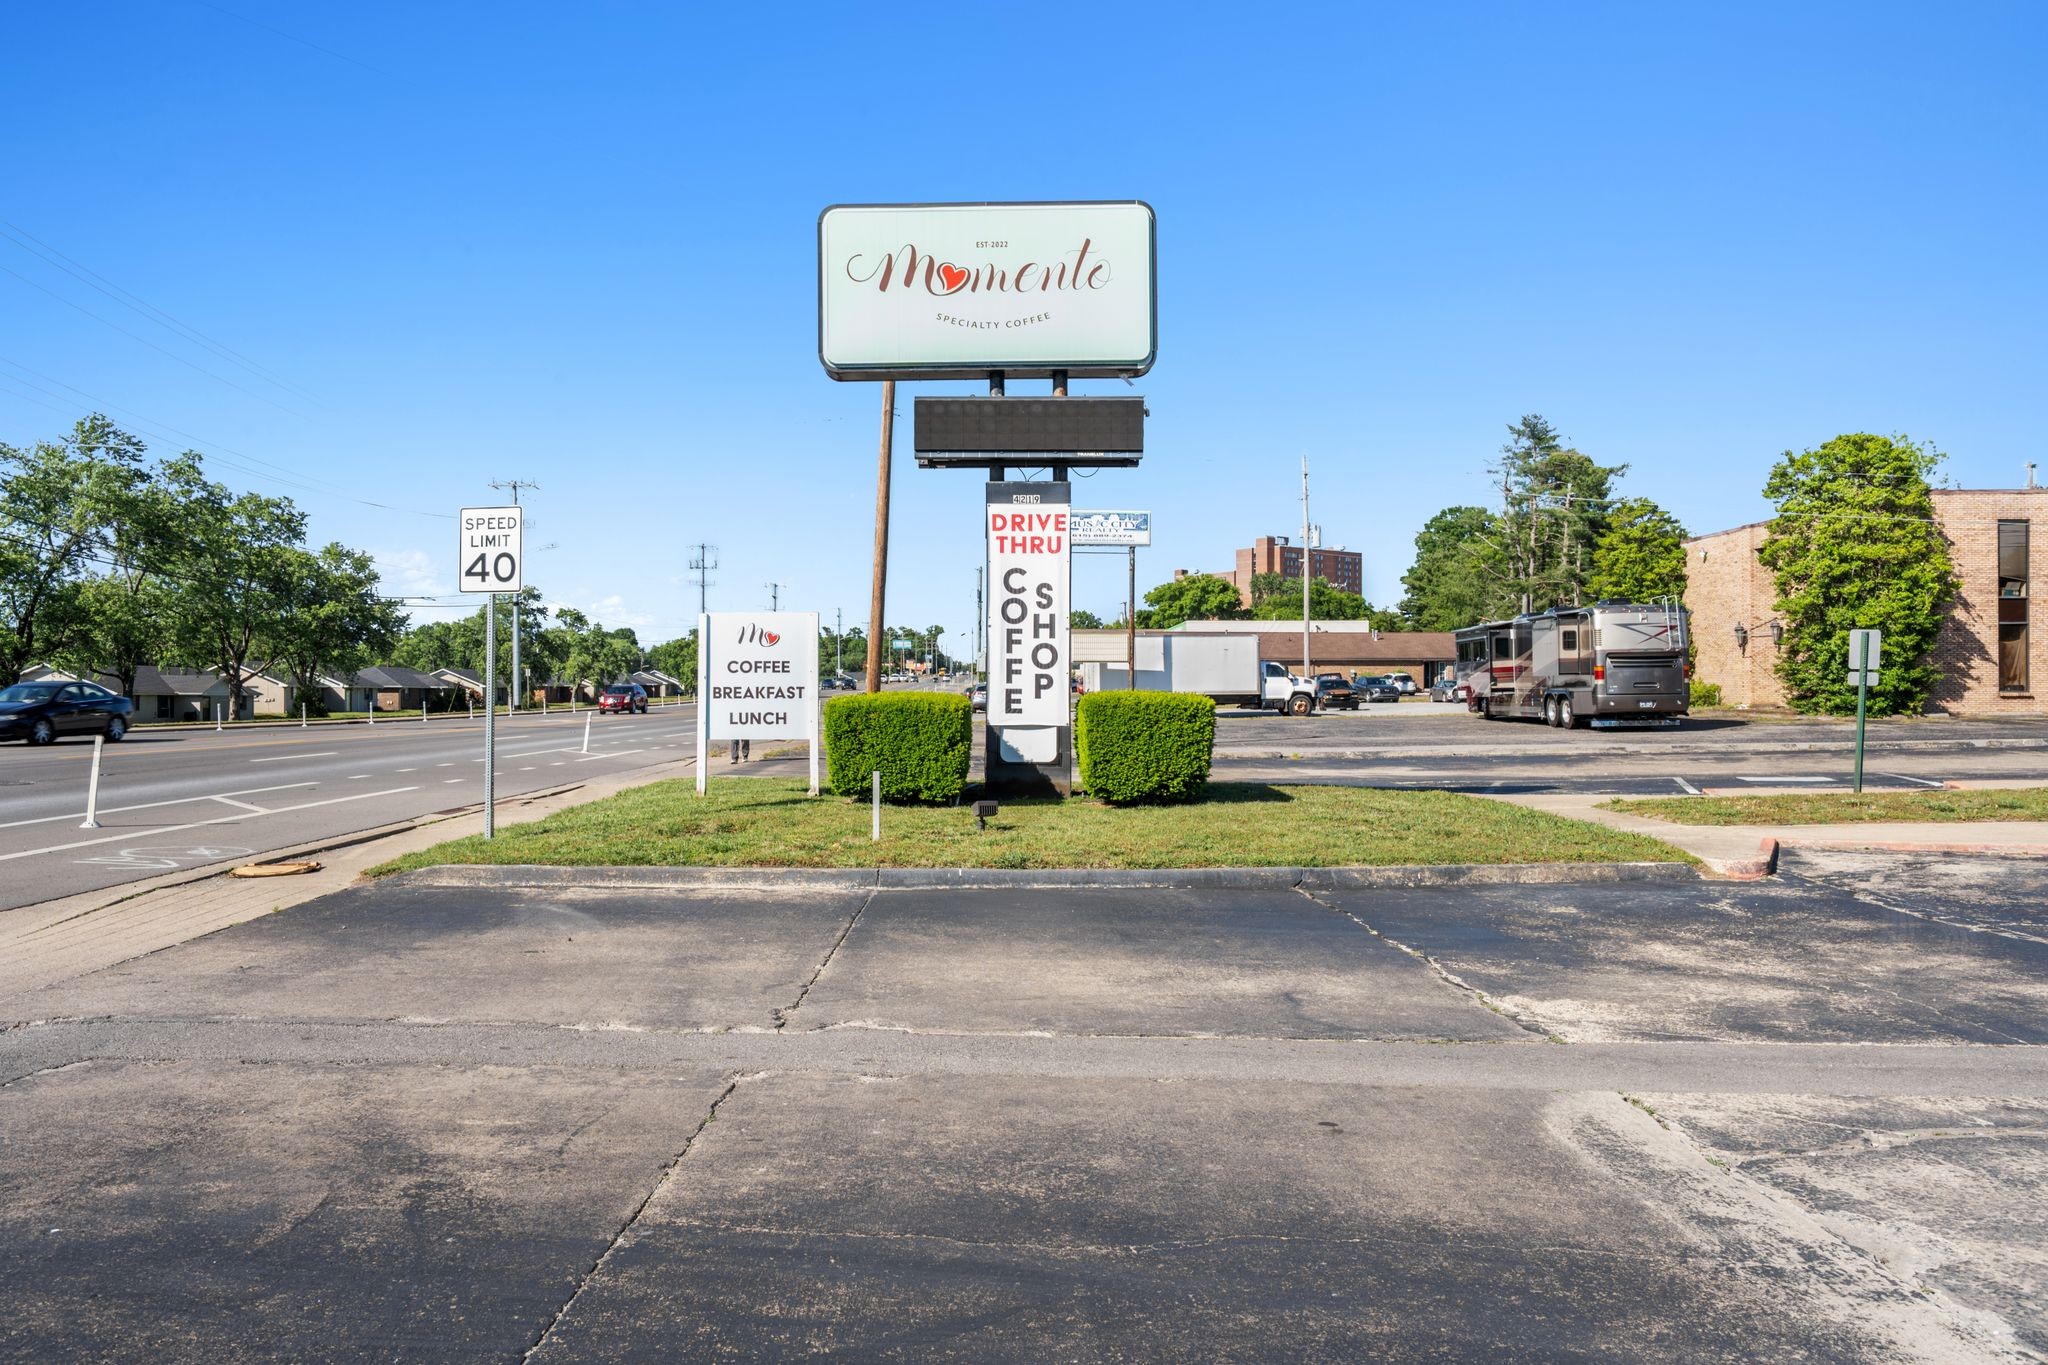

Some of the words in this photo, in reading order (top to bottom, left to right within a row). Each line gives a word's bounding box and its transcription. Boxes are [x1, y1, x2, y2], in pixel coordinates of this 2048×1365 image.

[936, 313, 1000, 329] SPECIALTY
[1005, 311, 1051, 328] COFFEE
[1013, 495, 1040, 504] 4219
[465, 517, 517, 530] SPEED
[992, 513, 1067, 532] DRIVE
[470, 534, 511, 547] LIMIT
[996, 536, 1062, 554] THRU
[464, 552, 516, 582] 40
[1001, 567, 1028, 714] COFFEE
[1031, 582, 1059, 699] SHOP
[727, 660, 791, 673] COFFEE
[712, 686, 805, 699] BREAKFAST
[729, 712, 787, 725] LUNCH
